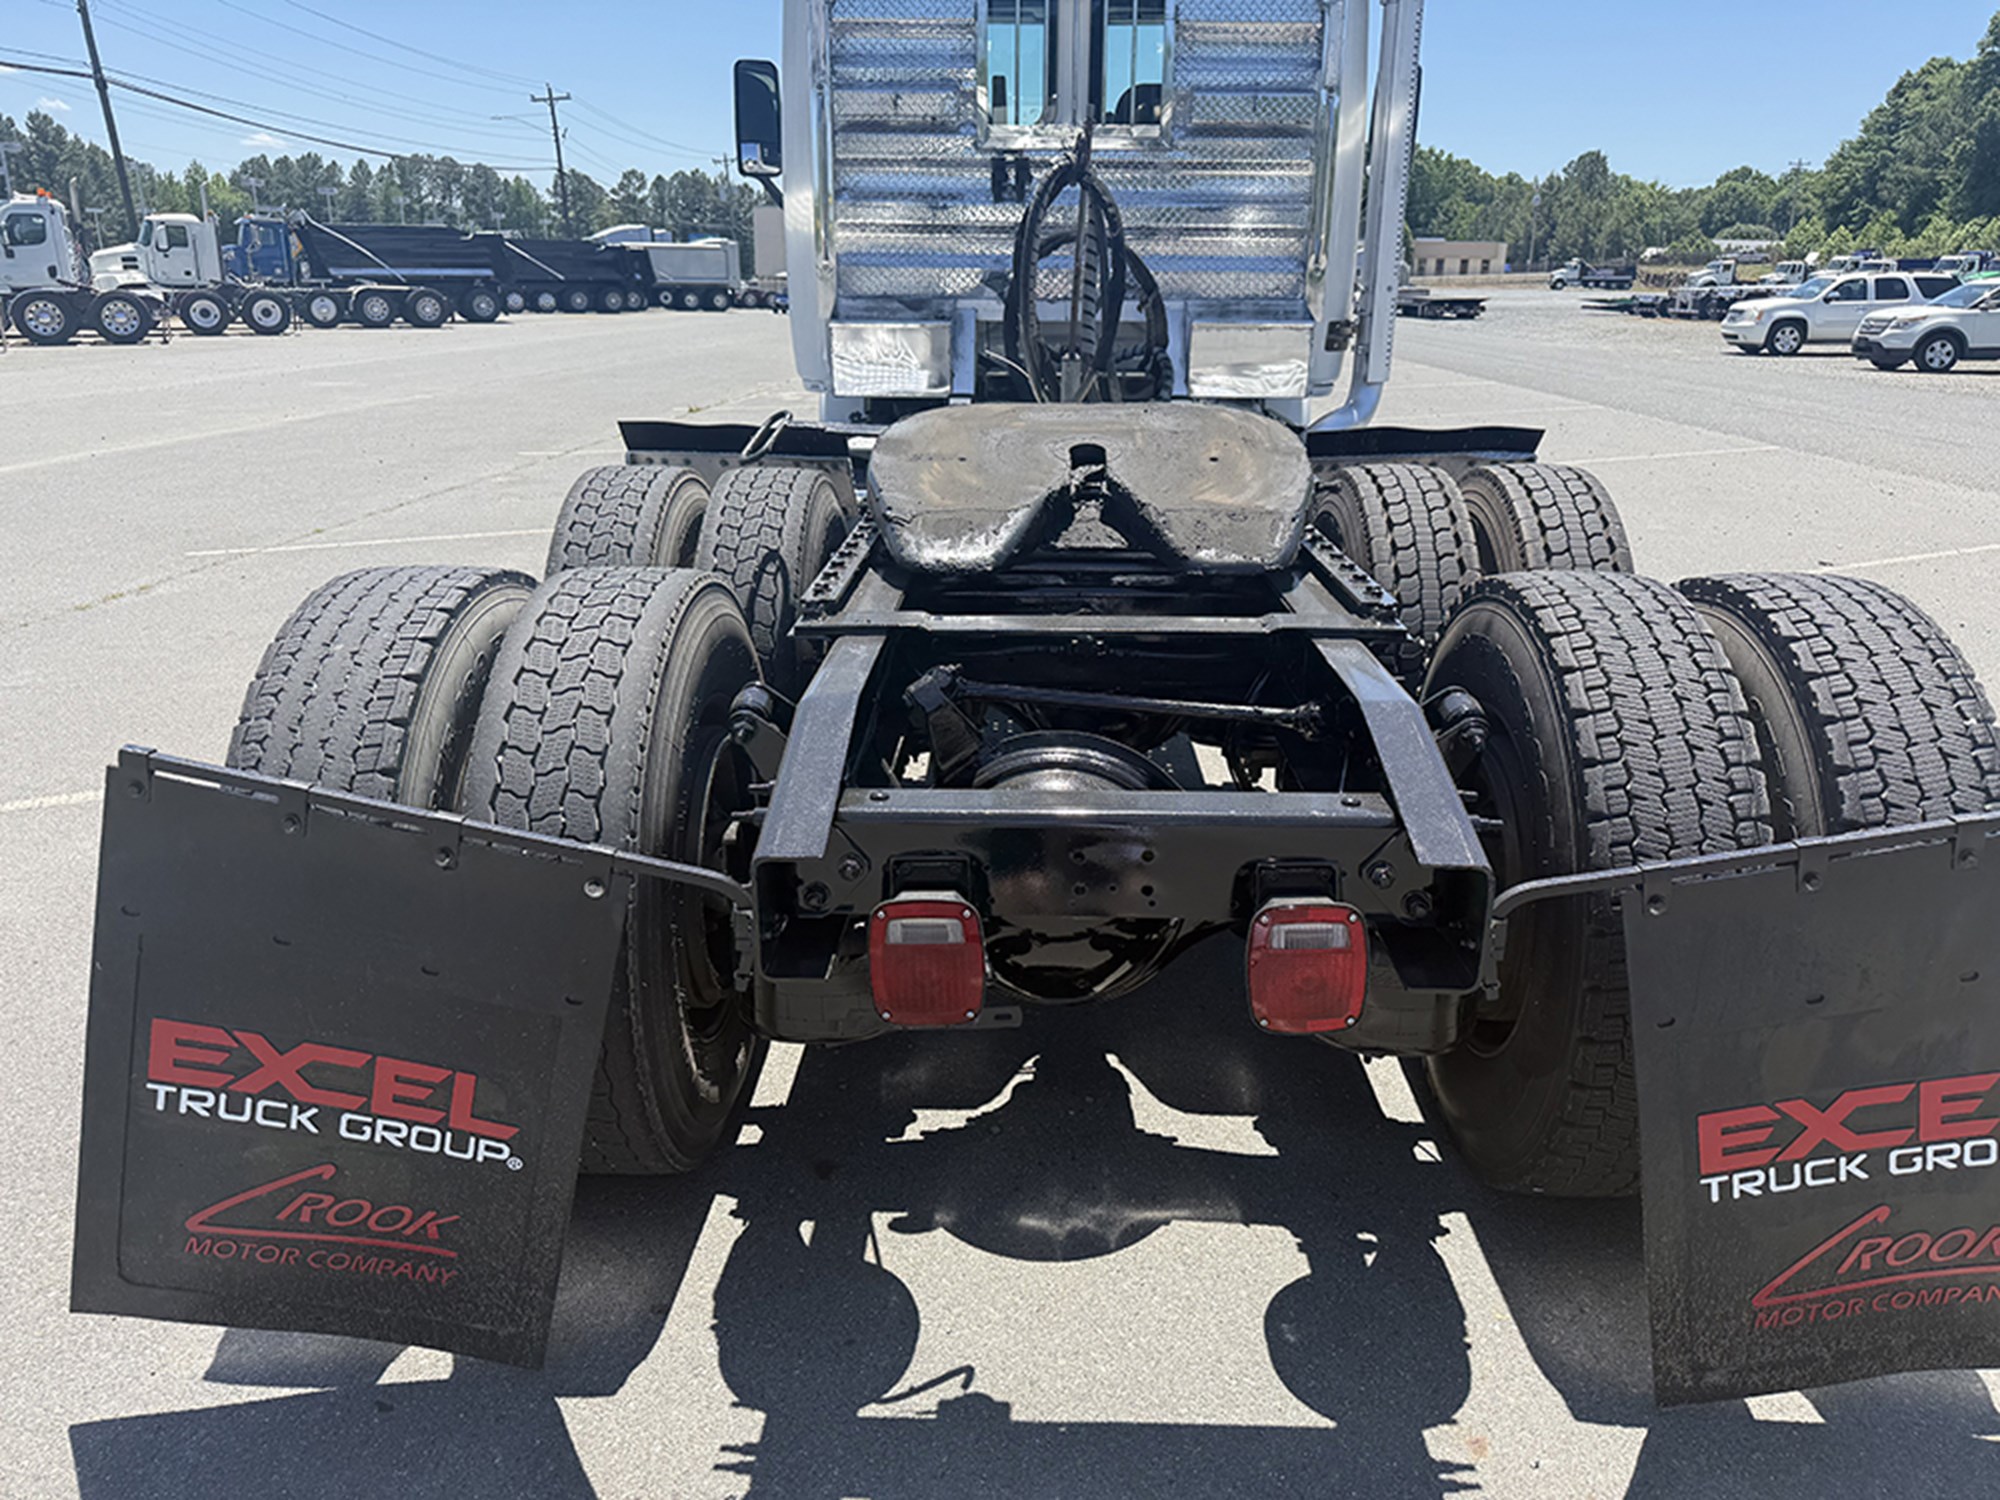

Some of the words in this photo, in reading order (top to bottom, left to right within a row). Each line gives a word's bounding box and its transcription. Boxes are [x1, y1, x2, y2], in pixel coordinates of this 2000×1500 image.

[147, 1017, 520, 1140] EXCEL
[145, 1082, 320, 1135] TRUCK
[1699, 1153, 1870, 1203] TRUCK
[184, 1236, 301, 1266] MOTOR
[305, 1249, 459, 1286] COMPANY
[1754, 1298, 1866, 1329] MOTOR
